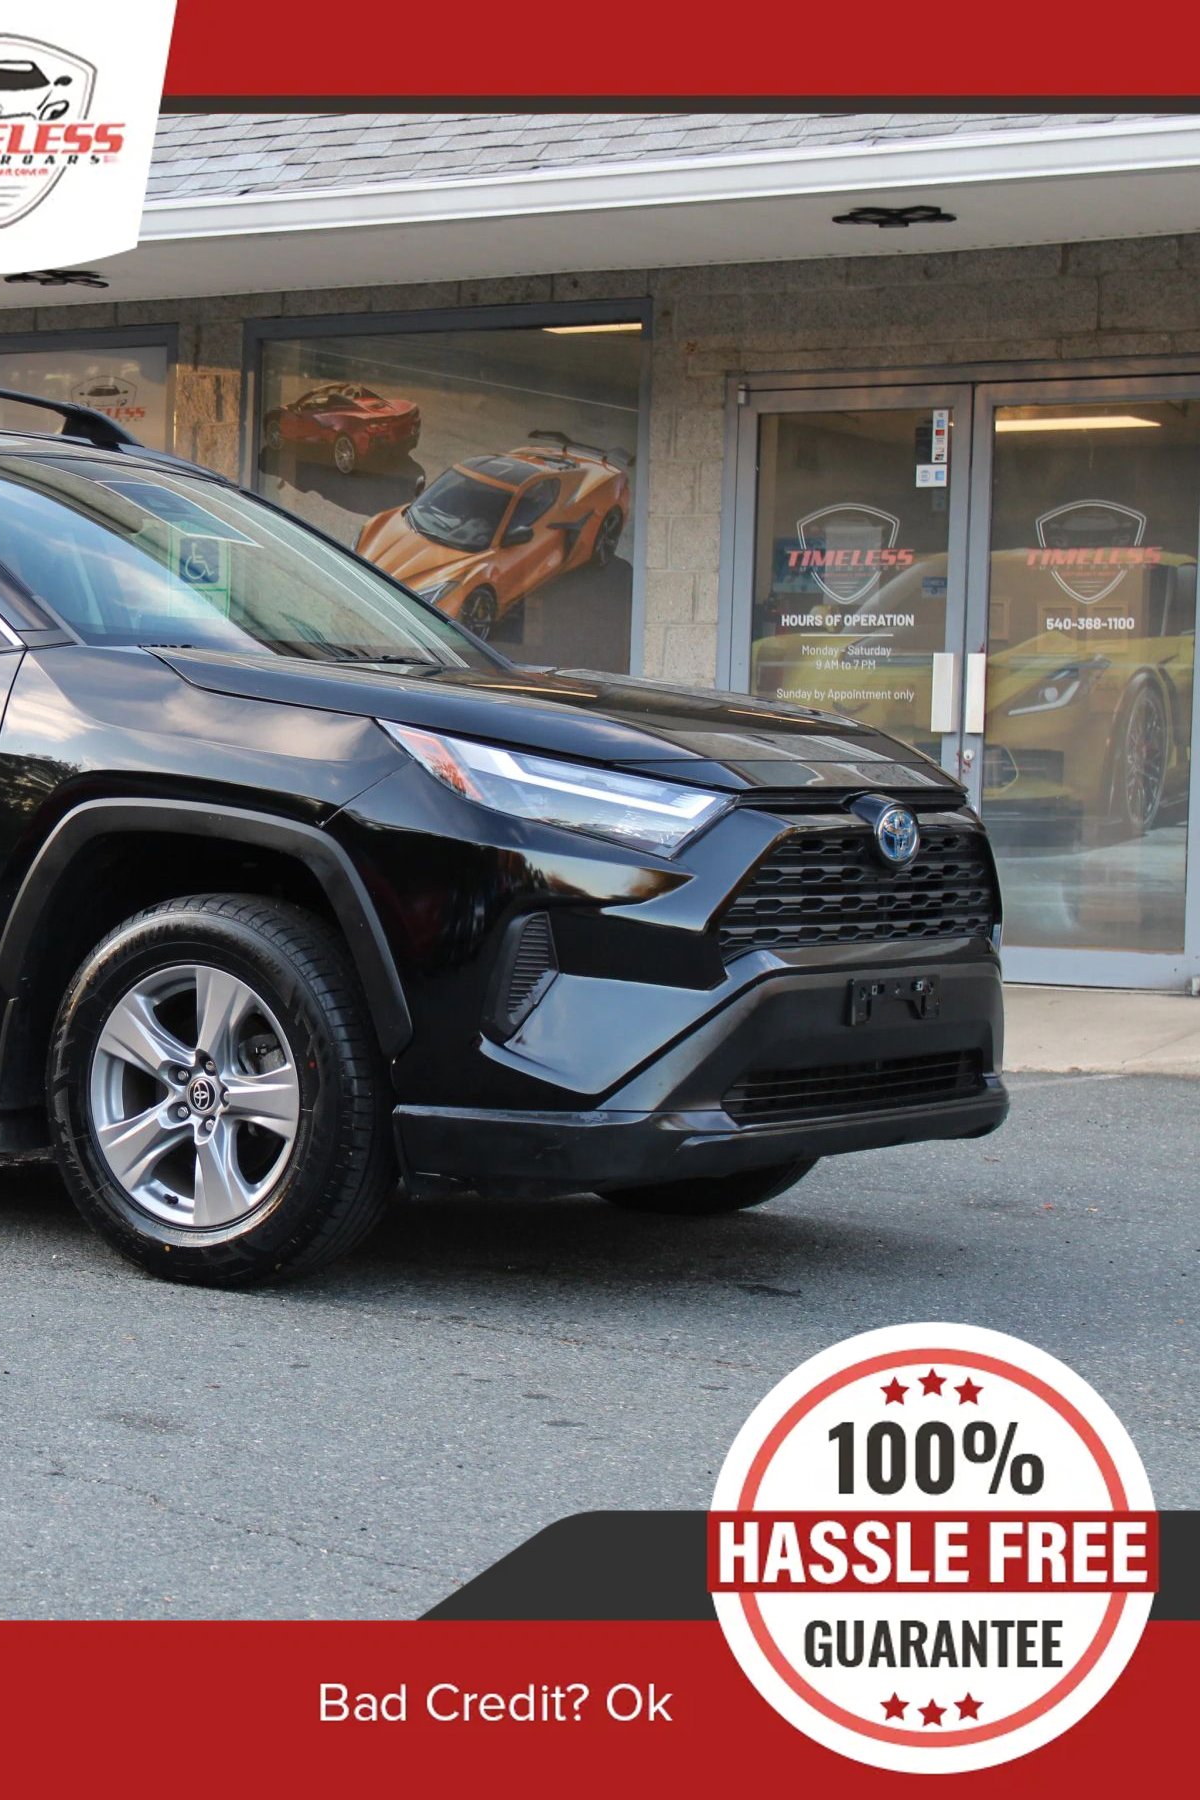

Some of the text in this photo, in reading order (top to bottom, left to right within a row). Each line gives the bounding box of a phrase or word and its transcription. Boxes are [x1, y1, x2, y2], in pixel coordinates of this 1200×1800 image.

[785, 549, 915, 567] TIMELESS
[1026, 547, 1163, 566] TIMELESS
[781, 614, 915, 627] HOURS OF OPERATION
[1046, 617, 1135, 630] 540-368-1100
[801, 645, 839, 658] Monday
[847, 645, 892, 658] Saturday
[815, 659, 876, 670] 9 AM to 7 PM
[776, 688, 915, 702] Sunday by Appointment only
